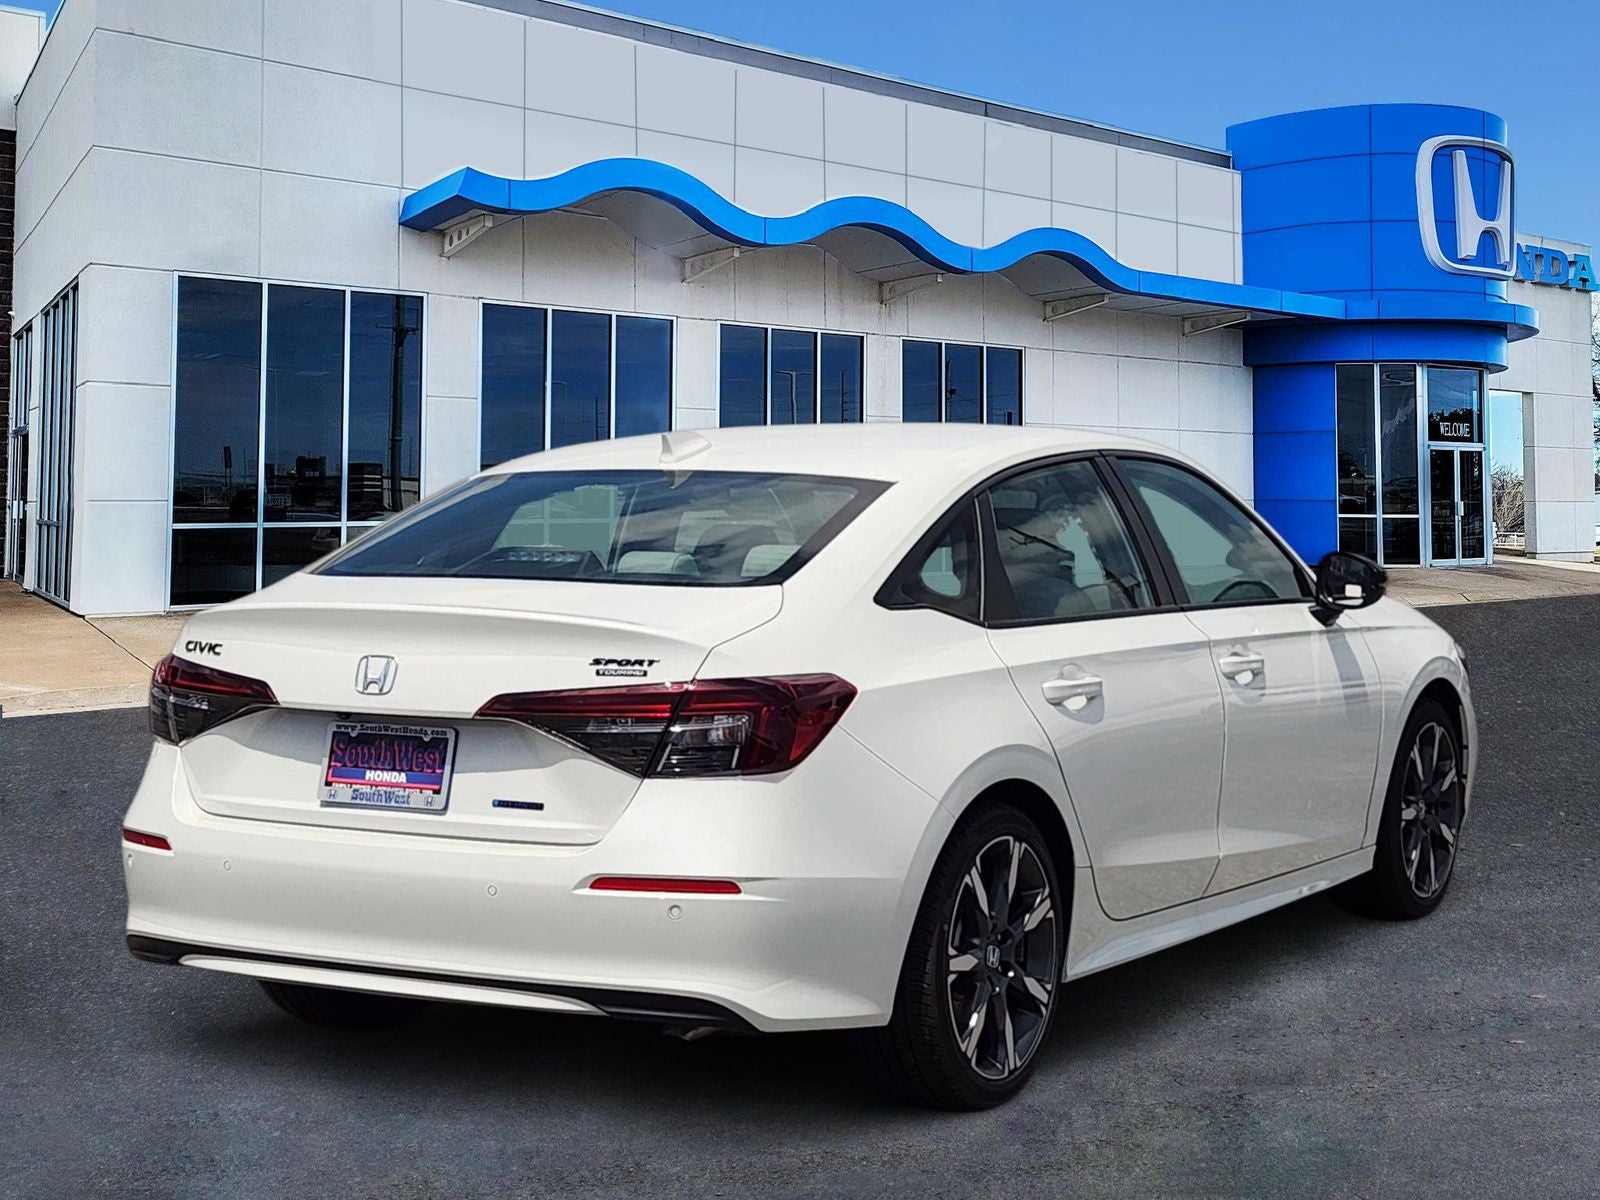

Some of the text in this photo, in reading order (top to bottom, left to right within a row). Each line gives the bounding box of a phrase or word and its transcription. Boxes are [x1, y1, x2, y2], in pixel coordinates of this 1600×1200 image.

[1439, 422, 1470, 437] WELCOME
[185, 640, 223, 656] CIVIC
[588, 658, 661, 667] SPORT
[598, 668, 646, 676] TOURING
[335, 723, 448, 737] www.SouthWestHonda.com
[365, 770, 407, 783] HONDA
[351, 788, 411, 805] SouthWest
